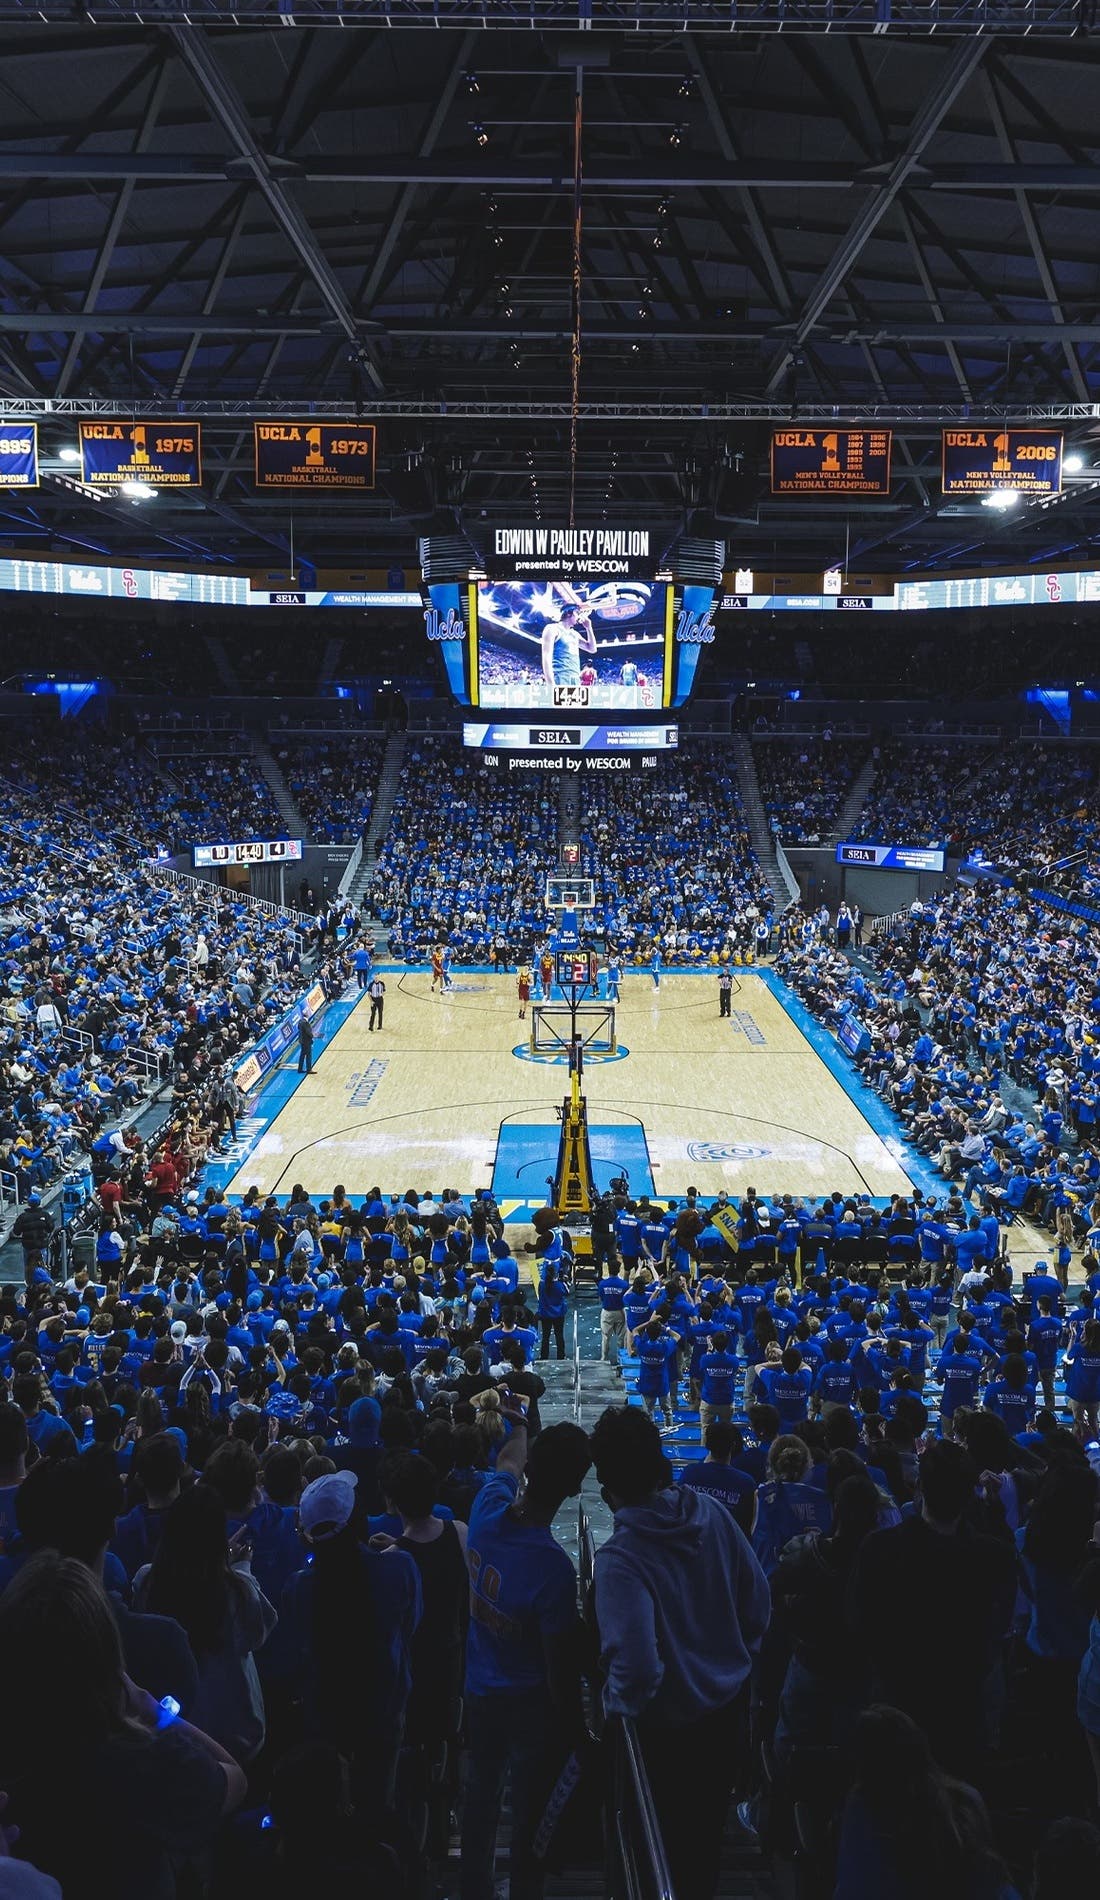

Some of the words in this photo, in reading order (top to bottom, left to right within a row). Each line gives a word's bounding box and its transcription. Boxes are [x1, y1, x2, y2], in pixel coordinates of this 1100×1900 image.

[83, 426, 124, 439] UCLA
[259, 427, 301, 440] UCLA
[156, 439, 194, 453] 1975
[775, 433, 816, 446] UCLA
[946, 433, 987, 446] UCLA
[331, 441, 368, 455] 1973
[1016, 446, 1056, 460] 2006
[90, 472, 135, 481] NATIONAL
[138, 473, 190, 482] CHAMPIONS
[265, 474, 311, 483] NATIONAL
[313, 475, 365, 484] CHAMPIONS
[828, 481, 880, 489] CHAMPIONS
[950, 480, 997, 488] NATIONAL
[999, 481, 1051, 489] CHAMPIONS
[495, 529, 534, 555] EDWIN
[535, 529, 548, 555] W
[550, 529, 595, 556] PAULEY
[596, 530, 649, 557] PAVILION
[515, 559, 560, 571] presented
[562, 559, 574, 571] by
[576, 560, 629, 573] WESCOM
[275, 594, 300, 603] SEIA
[842, 599, 867, 608] SEIA
[423, 608, 467, 641] Ucla
[677, 610, 716, 643] Ucla
[538, 731, 572, 744] SEIA
[509, 757, 564, 770] presented
[566, 757, 582, 772] by
[586, 757, 631, 769] WESCOM
[847, 850, 870, 860] SEIA
[562, 953, 588, 964] 14:40
[574, 963, 584, 982] 2
